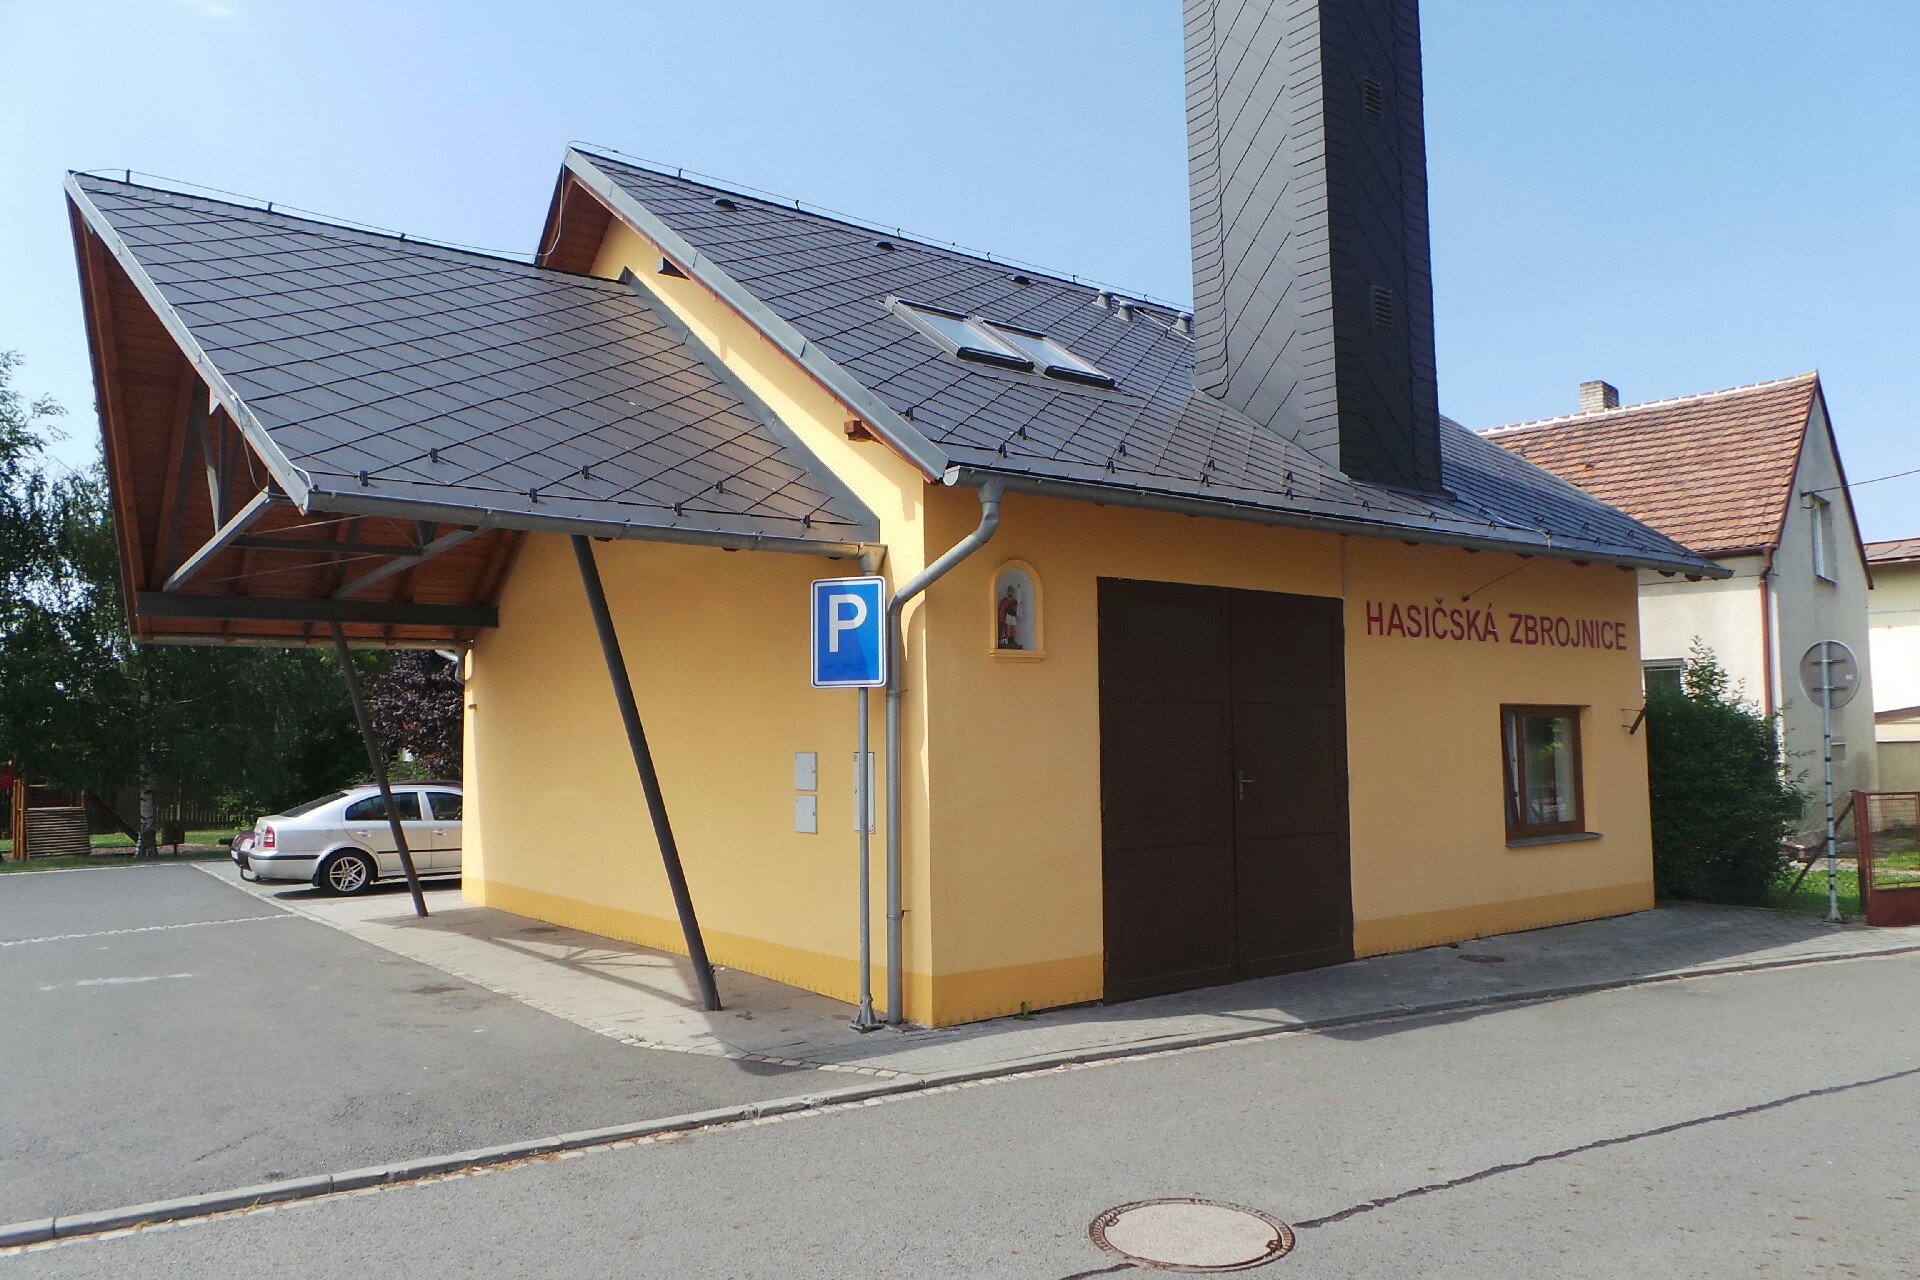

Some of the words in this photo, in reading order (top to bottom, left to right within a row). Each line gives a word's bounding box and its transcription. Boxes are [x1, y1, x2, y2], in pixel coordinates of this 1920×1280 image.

[828, 594, 867, 652] P
[1366, 598, 1499, 642] HASIČSKÁ
[1508, 613, 1627, 650] ZBROJNICE
